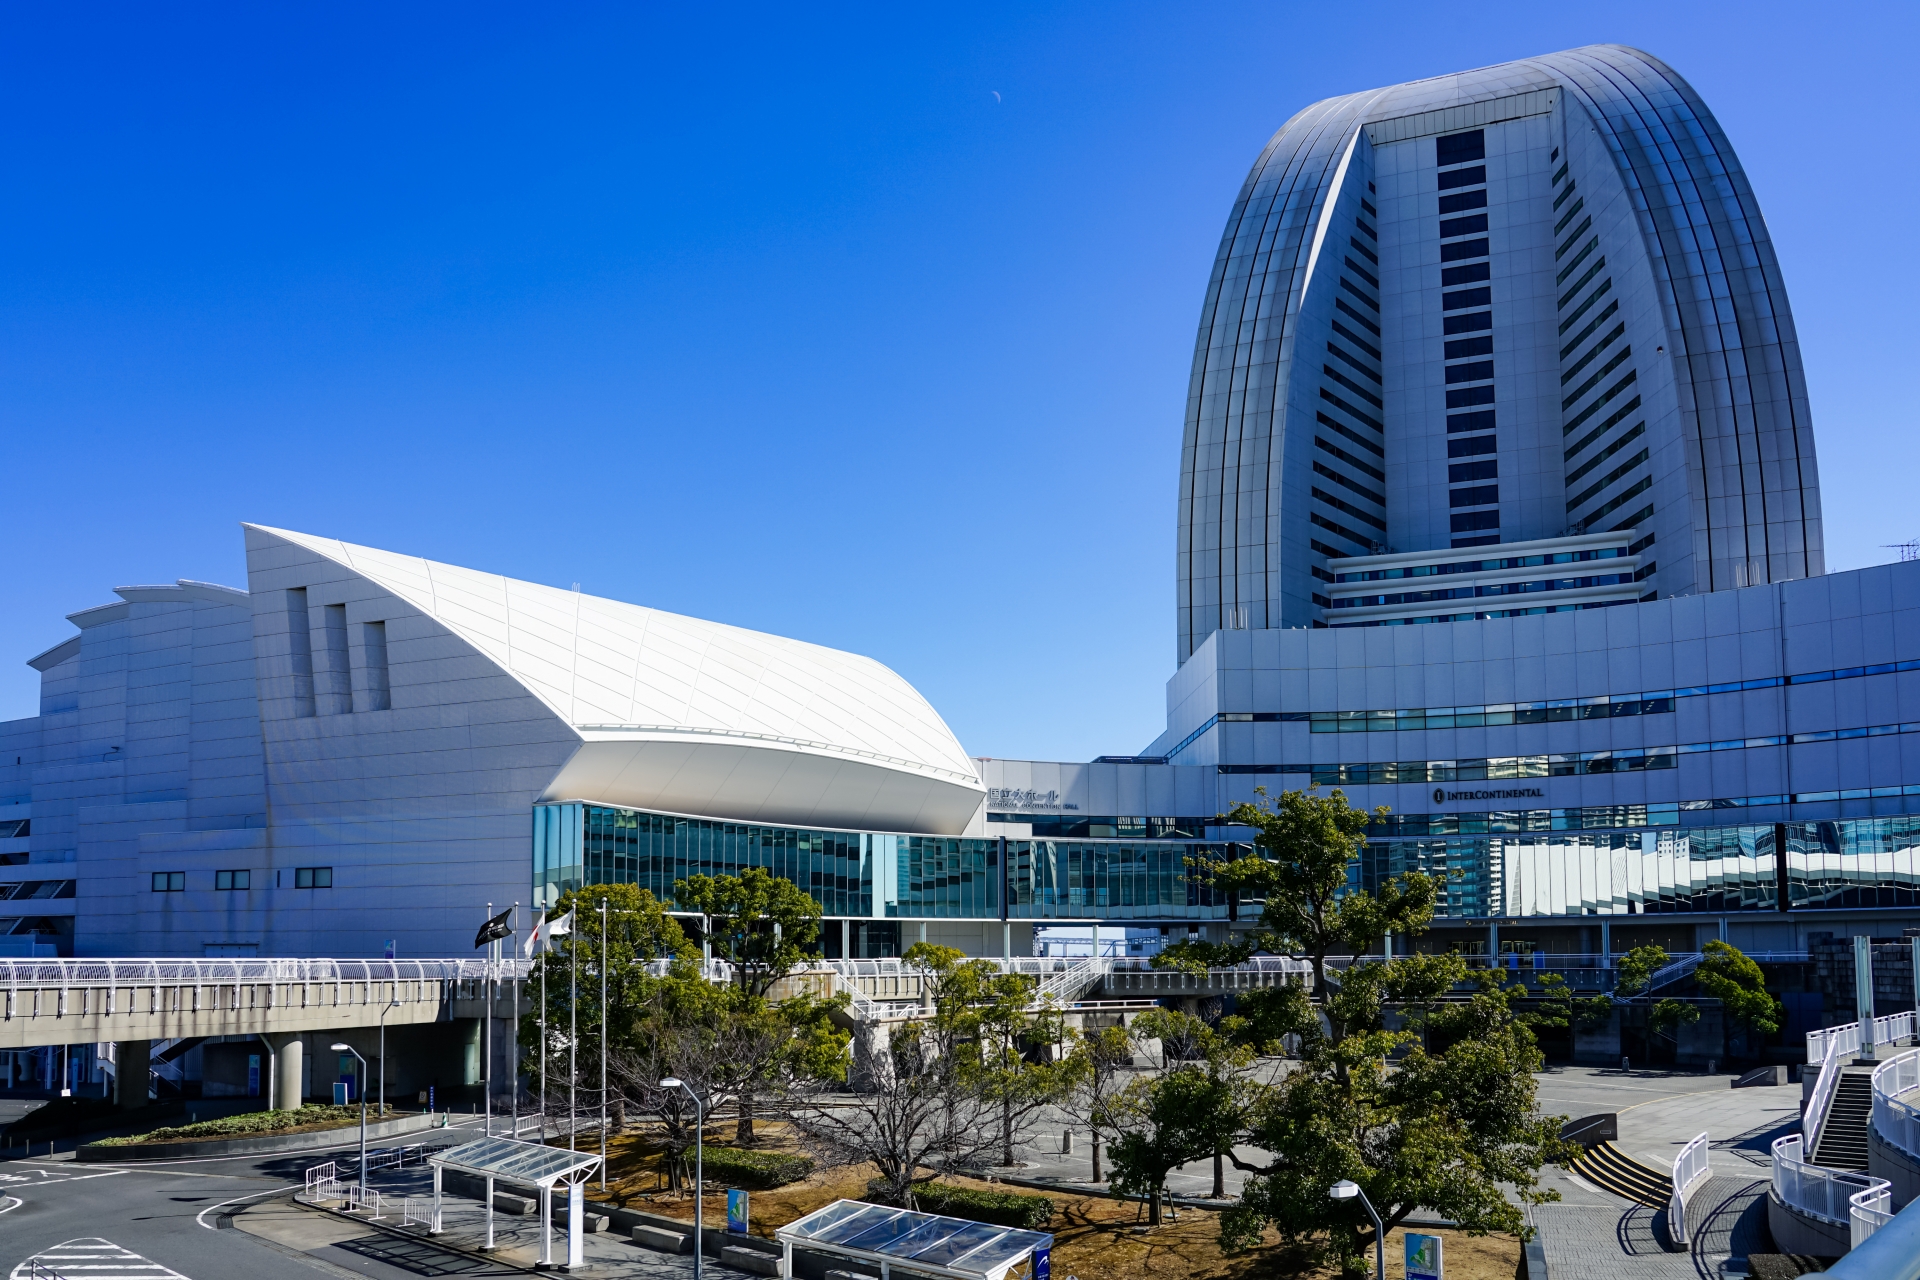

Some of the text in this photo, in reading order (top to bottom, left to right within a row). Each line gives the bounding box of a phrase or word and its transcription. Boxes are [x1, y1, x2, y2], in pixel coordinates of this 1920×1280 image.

[990, 788, 1059, 801] 国立大ホール
[1447, 789, 1544, 800] INTERCONTINENTAL
